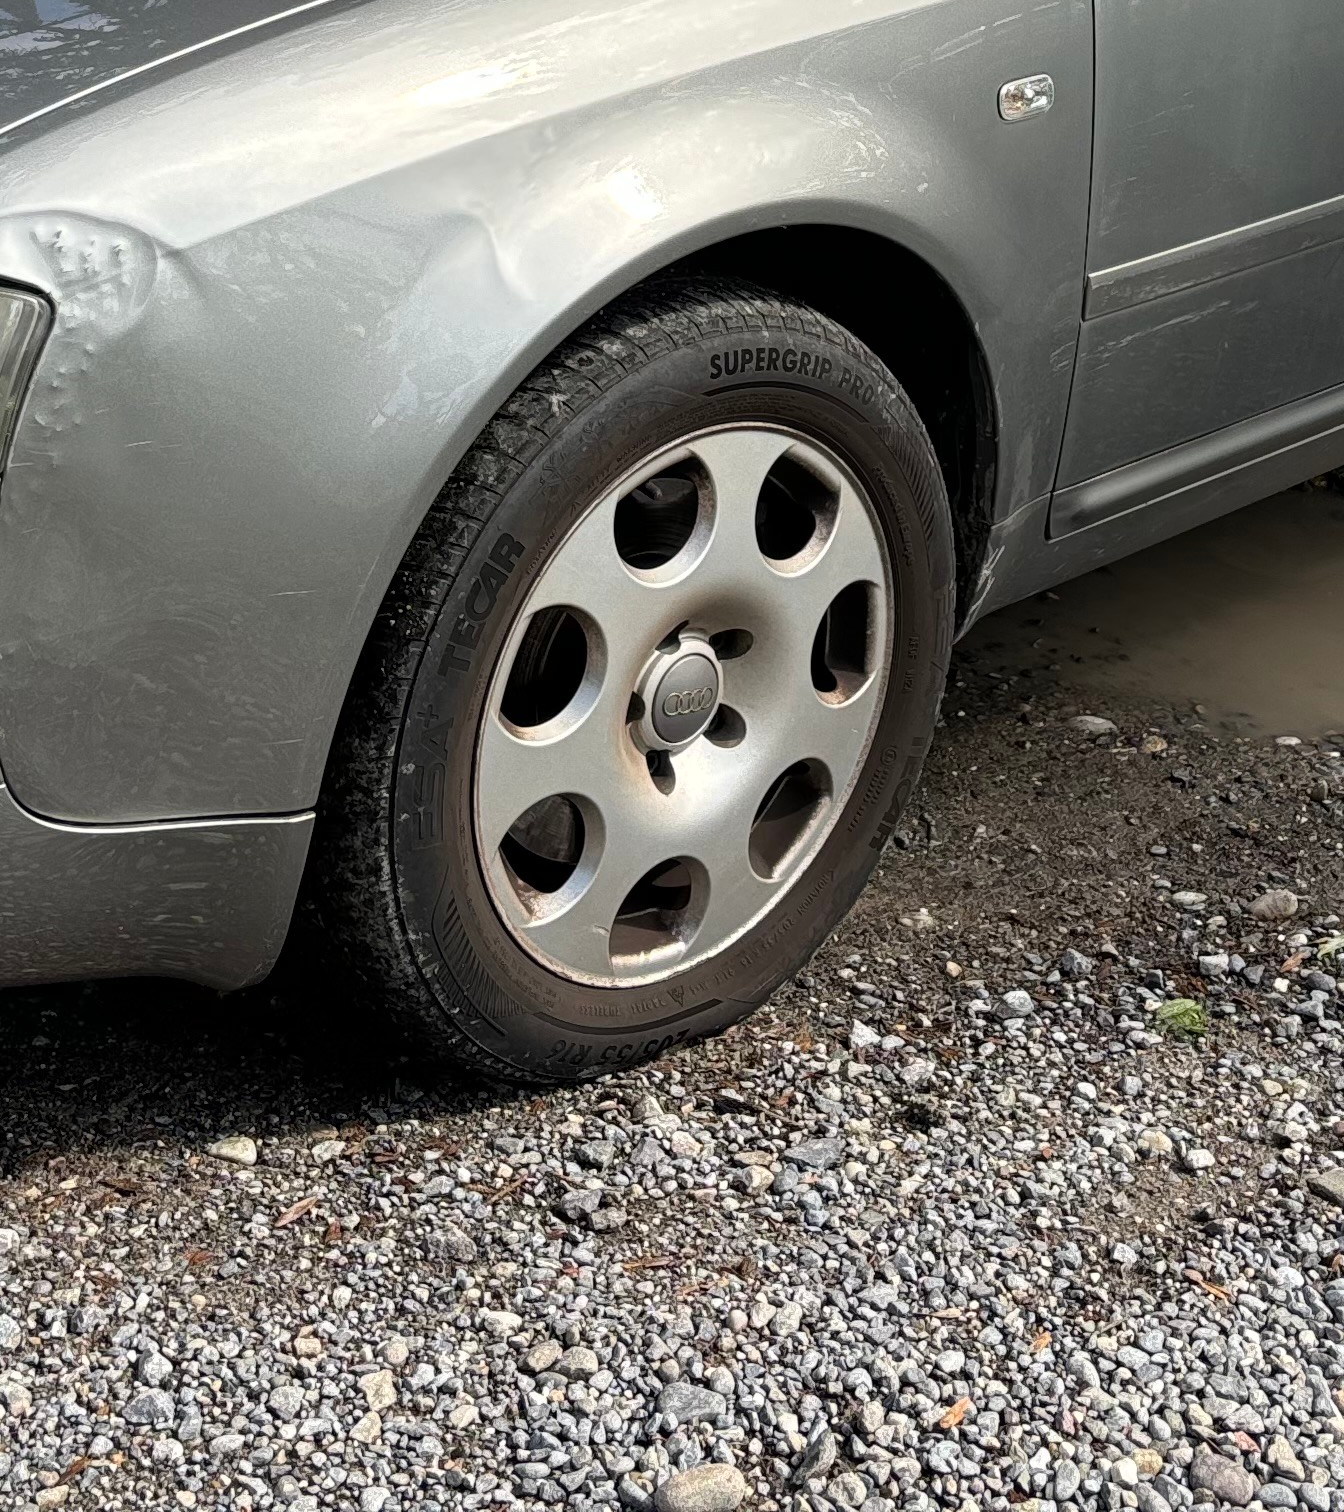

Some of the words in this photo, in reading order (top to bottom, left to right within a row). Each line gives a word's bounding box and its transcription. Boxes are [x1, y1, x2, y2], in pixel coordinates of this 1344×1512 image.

[708, 345, 836, 386] SUPERGRIP
[834, 365, 878, 408] PRO
[437, 531, 527, 678] TECAR
